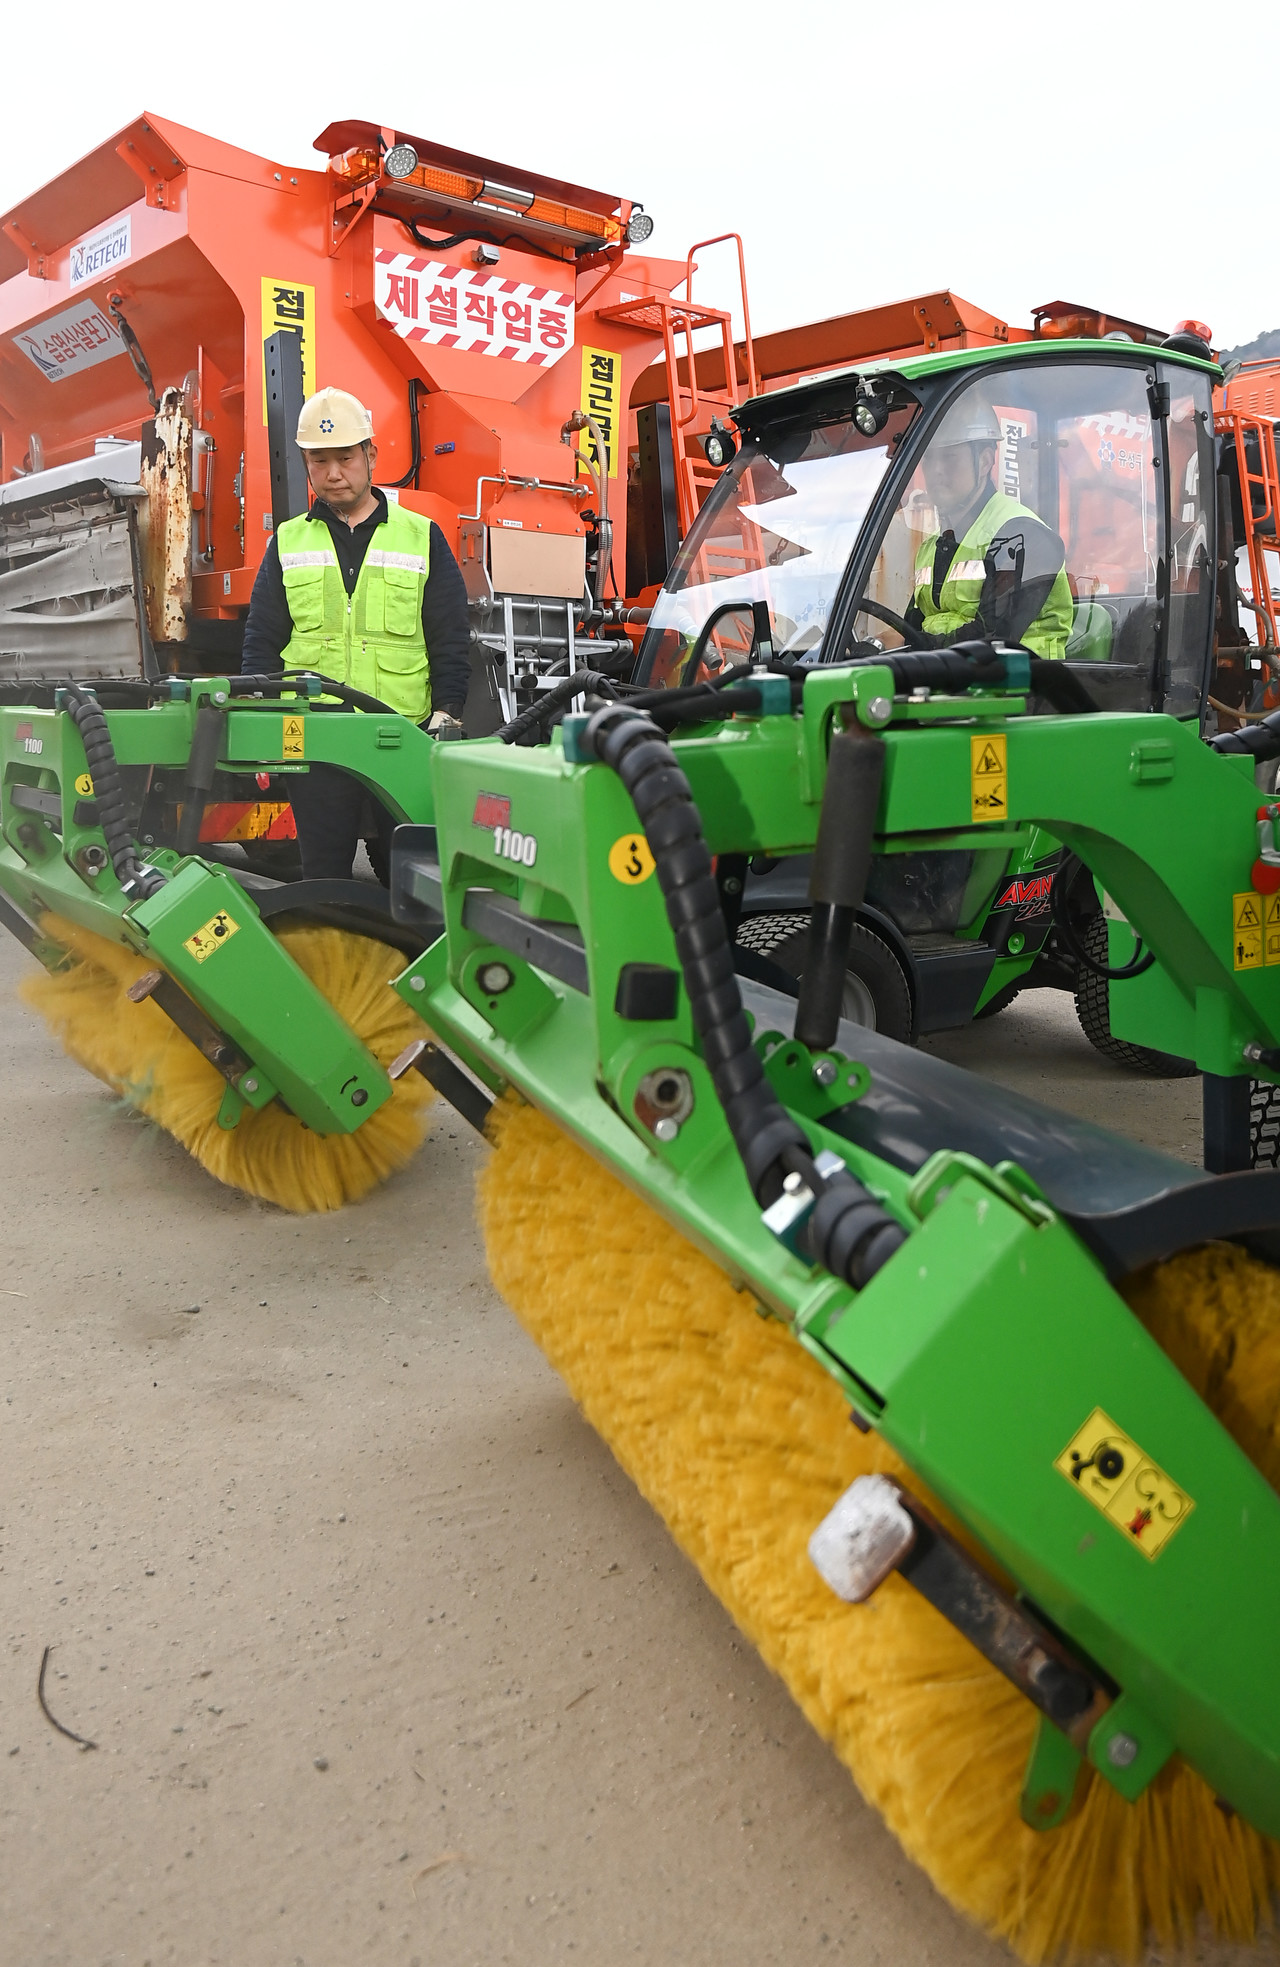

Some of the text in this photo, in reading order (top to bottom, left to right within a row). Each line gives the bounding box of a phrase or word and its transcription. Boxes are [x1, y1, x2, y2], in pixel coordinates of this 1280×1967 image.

[86, 235, 127, 274] RETECH
[384, 273, 568, 349] 제설작업중
[588, 354, 613, 472] 접근금지
[25, 737, 43, 754] 1100
[493, 825, 537, 868] 1100
[994, 872, 1057, 908] AVAN
